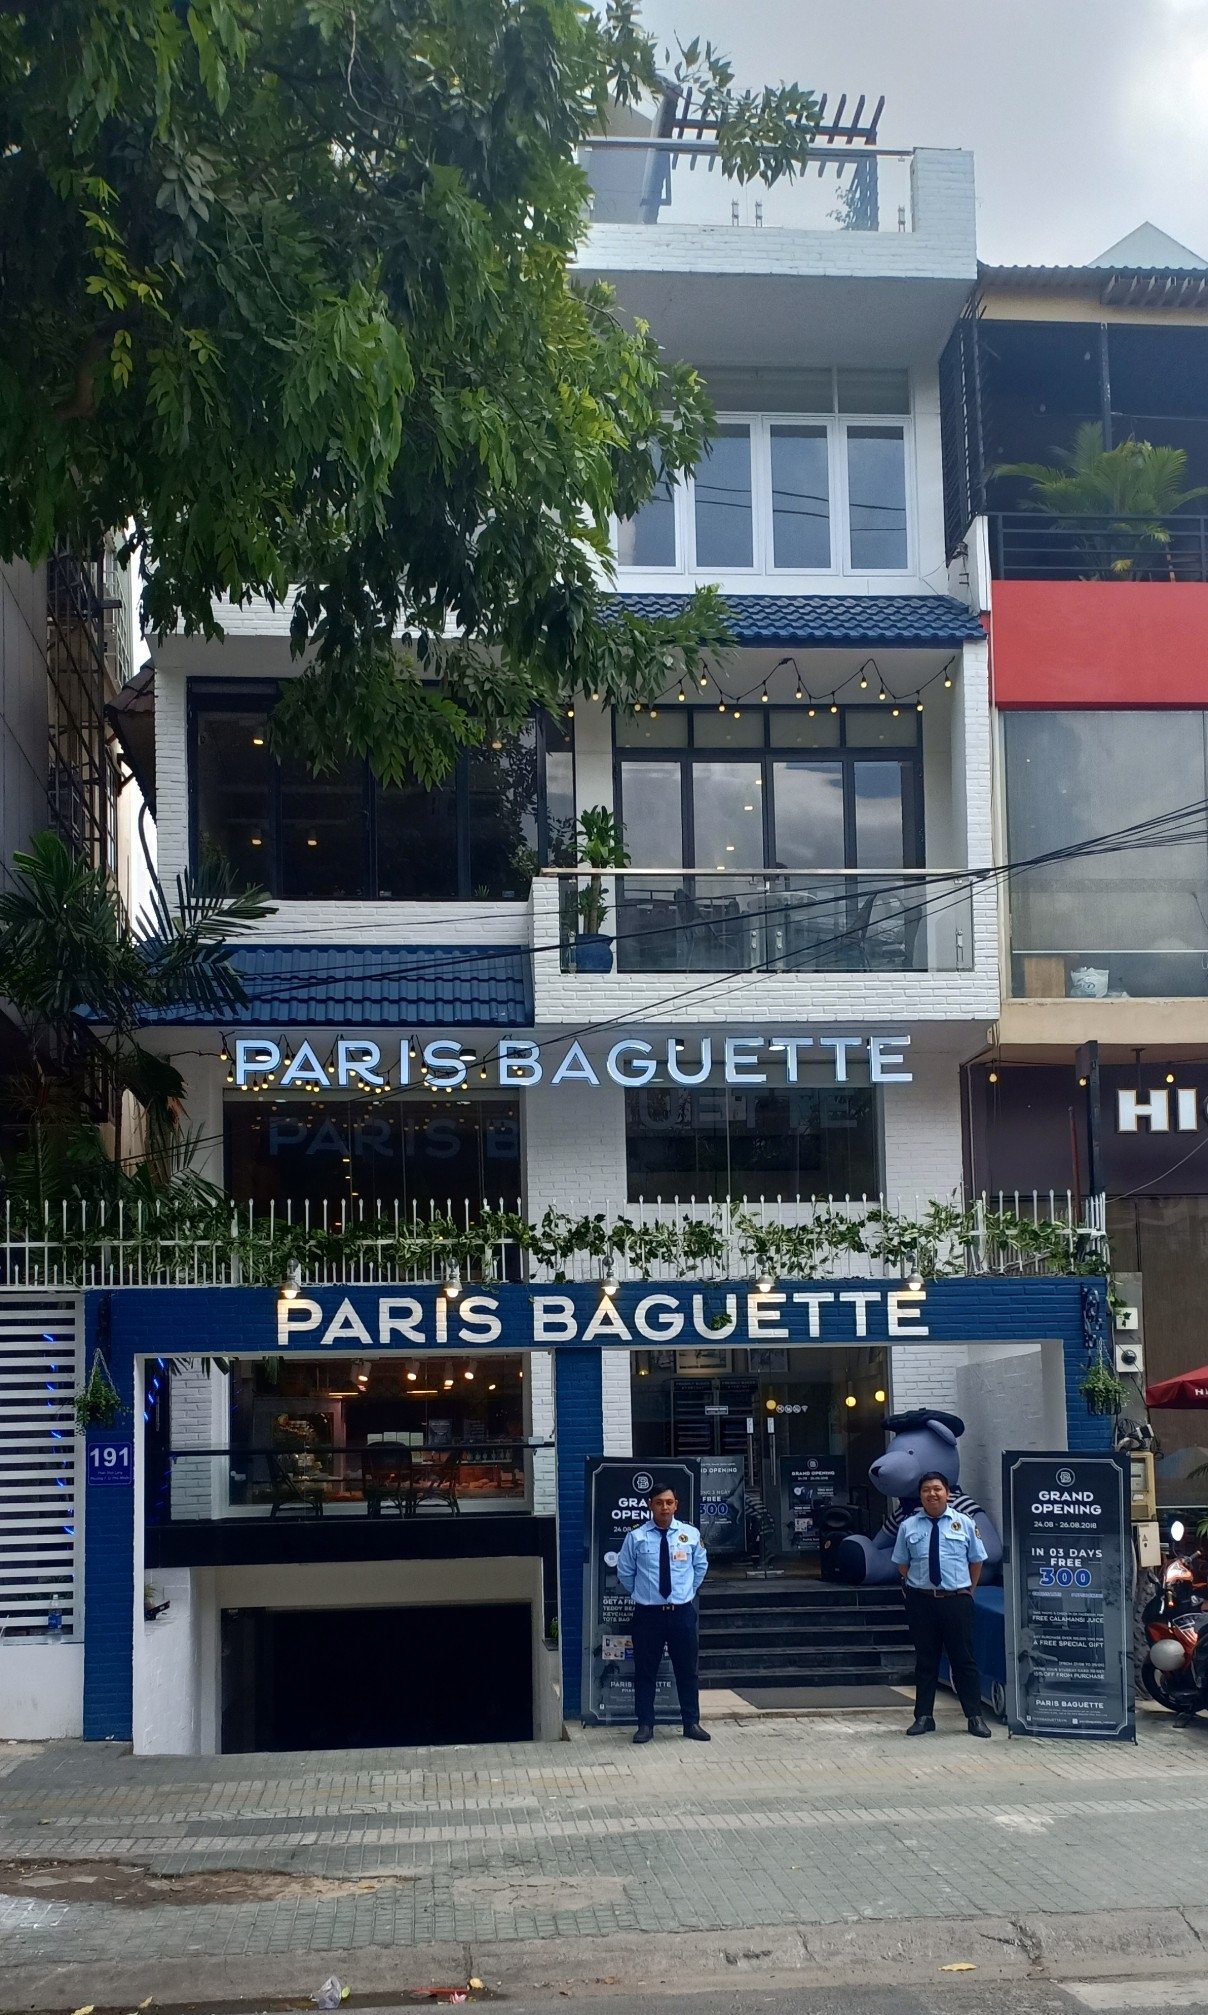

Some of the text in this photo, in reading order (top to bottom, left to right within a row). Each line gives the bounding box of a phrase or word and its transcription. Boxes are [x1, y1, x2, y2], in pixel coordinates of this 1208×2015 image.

[234, 1034, 914, 1089] PARIS BAGUETTE
[1116, 1088, 1208, 1133] HI
[277, 1291, 930, 1346] PARIS BAGUETTE
[89, 1446, 129, 1468] 191
[1038, 1490, 1094, 1502] GRAND
[618, 1497, 652, 1508] GRA
[611, 1510, 654, 1520] OPENI
[1031, 1503, 1102, 1515] OPENING
[1059, 1521, 1097, 1529] 26.08.2018
[1031, 1547, 1103, 1558] IN 03 DAYS
[1050, 1558, 1082, 1567] FREE
[1039, 1567, 1092, 1587] 300
[1035, 1699, 1104, 1709] PARIS BAGUETTE
